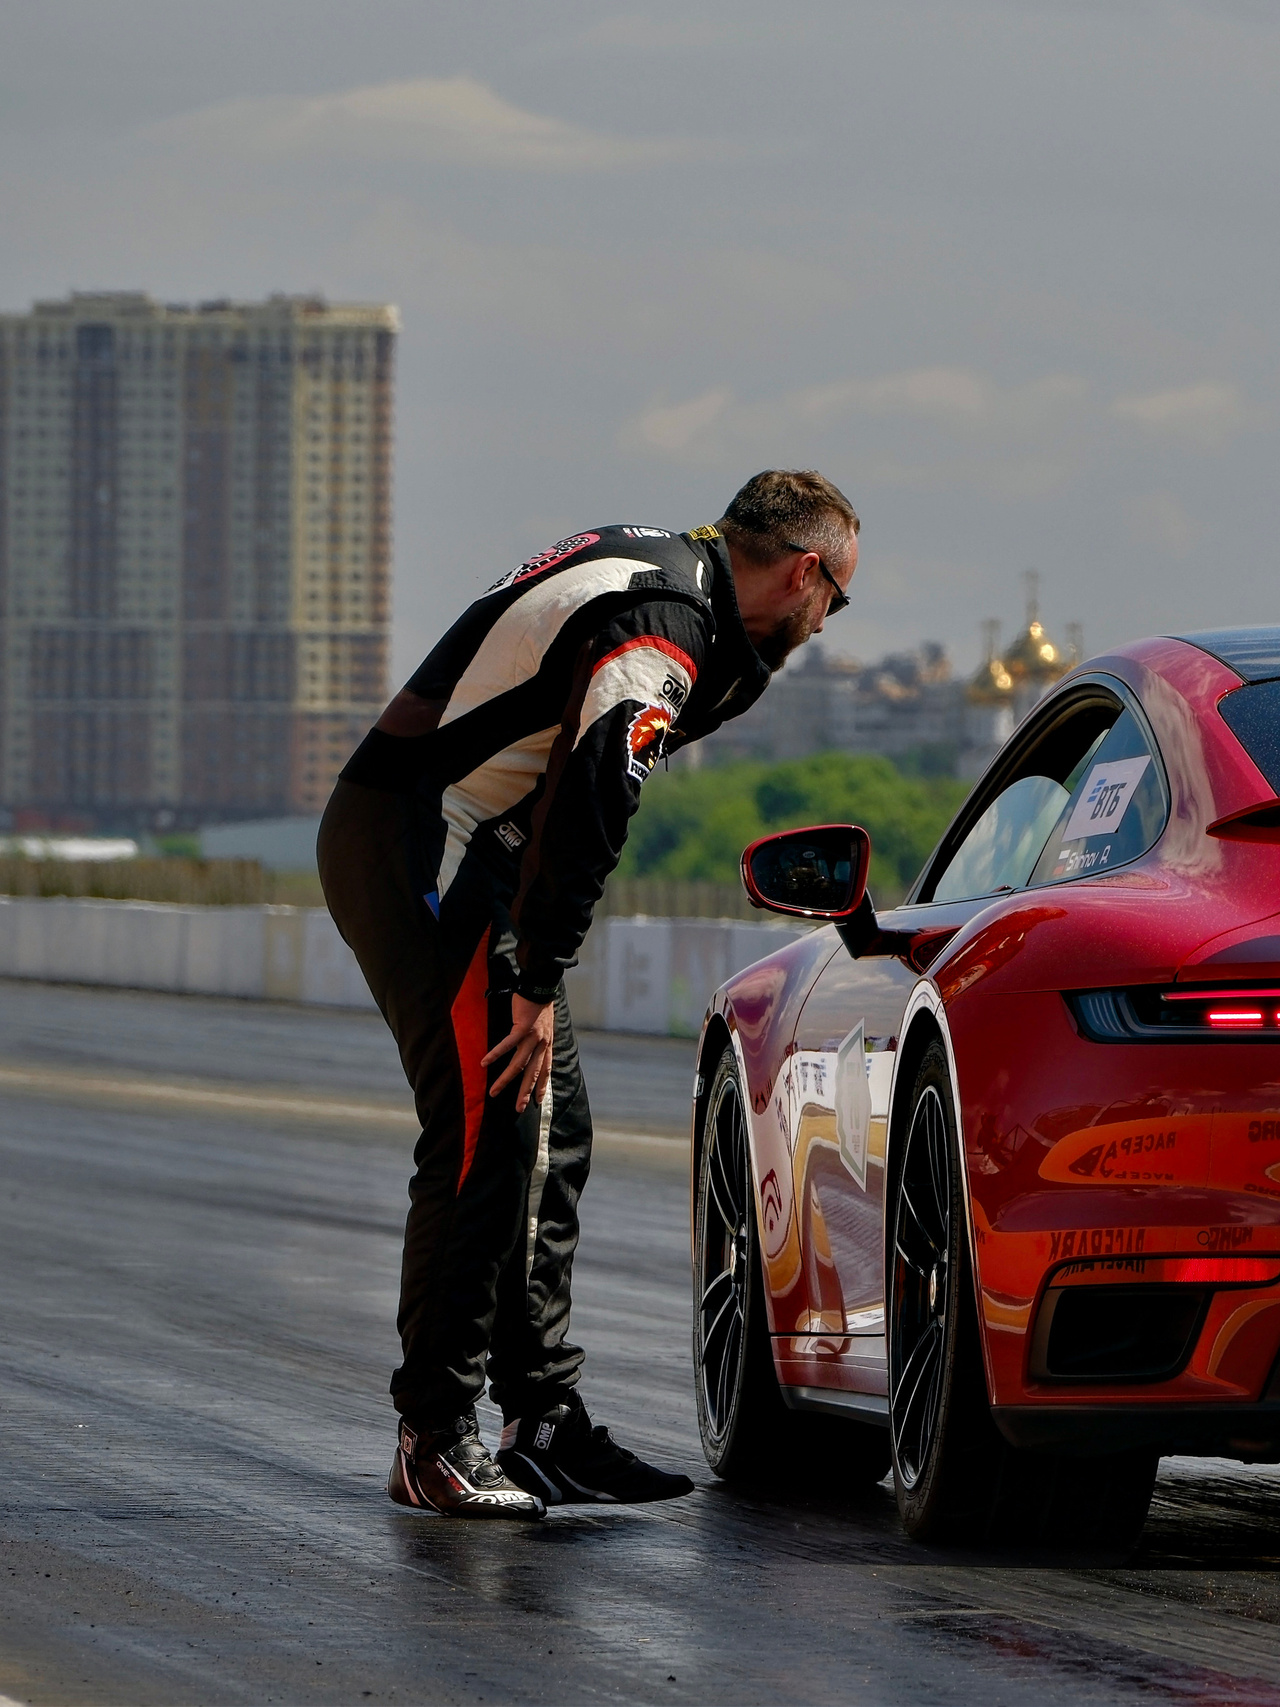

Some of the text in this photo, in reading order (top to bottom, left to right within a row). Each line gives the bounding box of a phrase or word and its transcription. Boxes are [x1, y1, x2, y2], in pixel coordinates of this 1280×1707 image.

[499, 824, 523, 847] OMP
[1099, 845, 1112, 865] A
[536, 1422, 551, 1449] OMP
